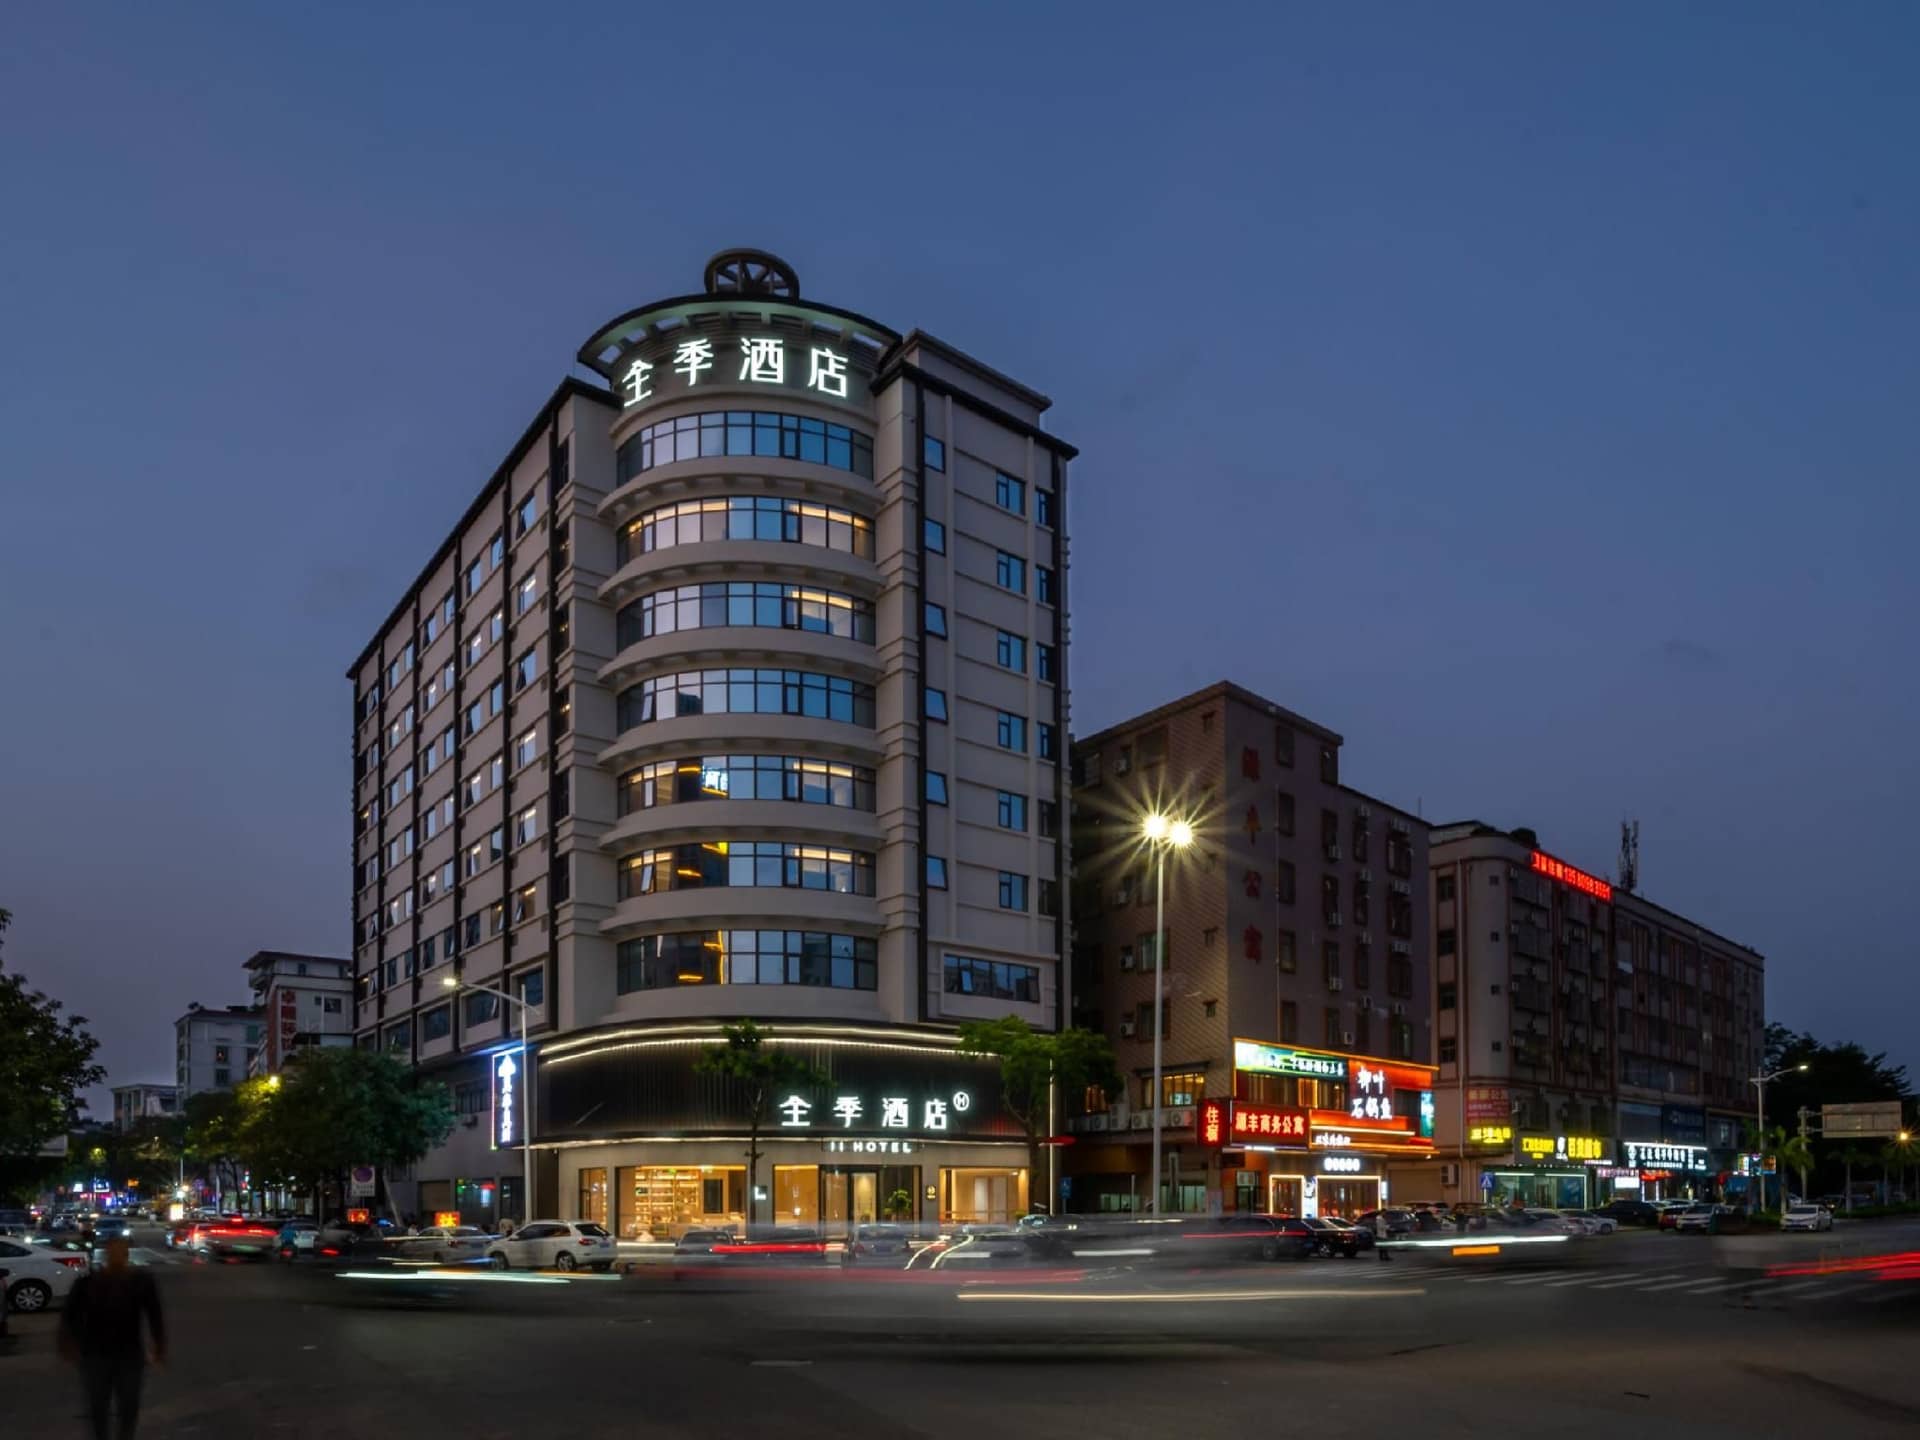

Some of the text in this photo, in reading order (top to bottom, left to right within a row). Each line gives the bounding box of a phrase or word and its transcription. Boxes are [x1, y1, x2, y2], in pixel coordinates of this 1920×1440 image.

[622, 337, 849, 407] 全季酒店
[779, 1095, 947, 1130] 全季酒店
[1206, 1106, 1219, 1142] 住宿
[853, 1142, 911, 1153] HOTEL
